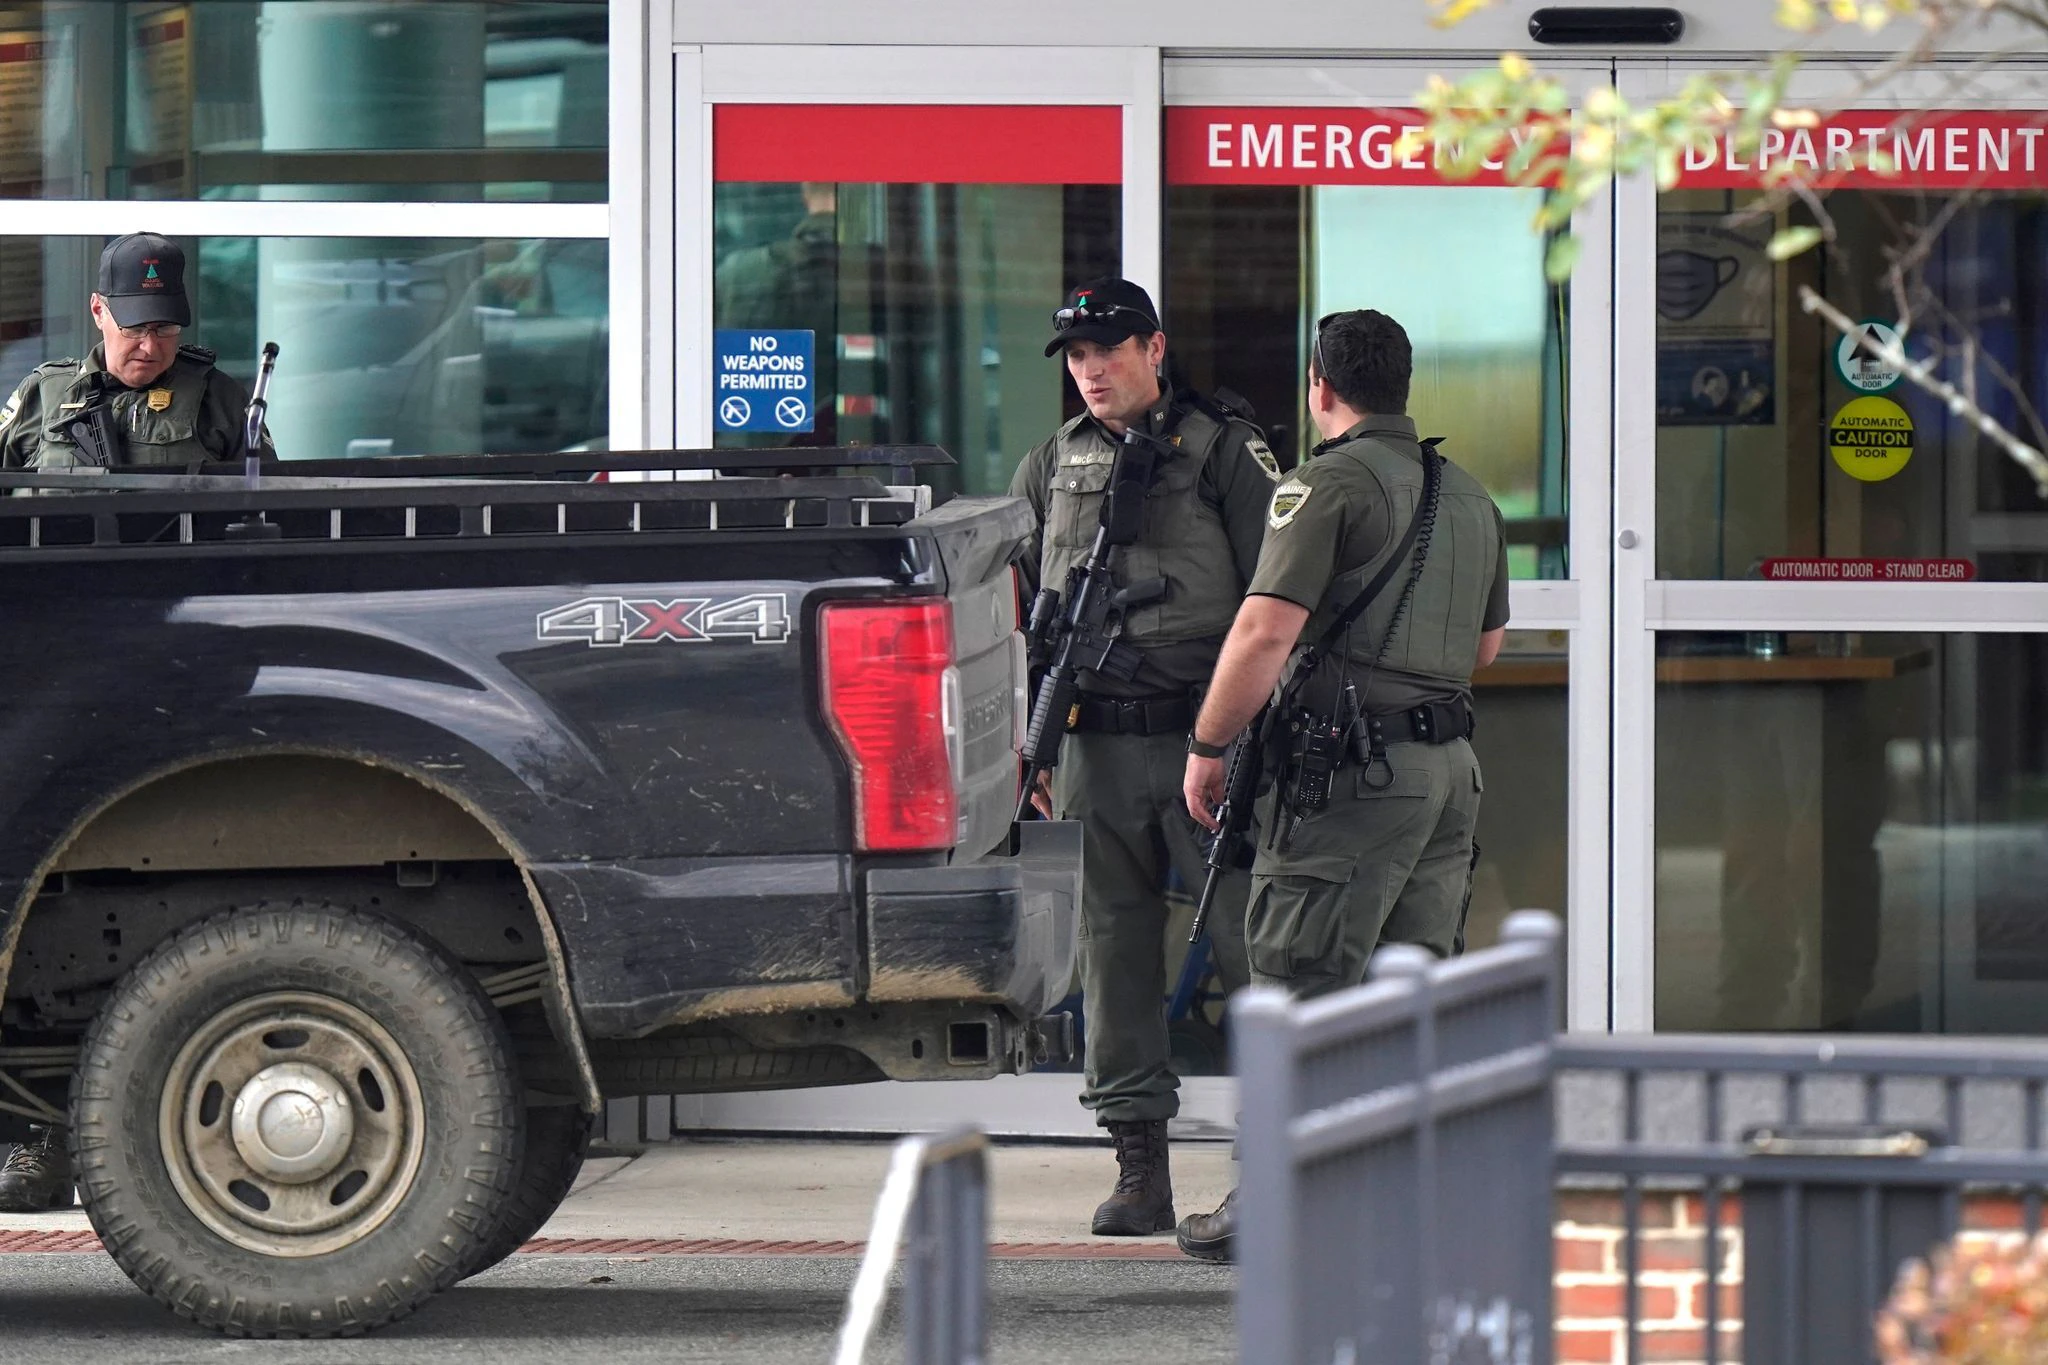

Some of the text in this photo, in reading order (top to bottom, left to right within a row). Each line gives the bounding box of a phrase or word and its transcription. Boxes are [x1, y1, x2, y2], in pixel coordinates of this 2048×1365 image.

[749, 335, 778, 352] NO
[722, 354, 805, 371] WEAPONS
[720, 374, 808, 390] PERMITTED
[1851, 372, 1893, 381] AUTOMATIC
[1862, 380, 1882, 388] DOOR
[1839, 417, 1905, 428] AUTOMATIC
[1834, 430, 1909, 446] CAUTION
[1854, 448, 1888, 459] DOOR
[1278, 485, 1306, 495] MAINE
[1771, 562, 1839, 578] AUTOMATIC
[1841, 562, 1874, 578] DOOR
[1885, 563, 1924, 578] STAND
[1927, 564, 1965, 579] CLEAR
